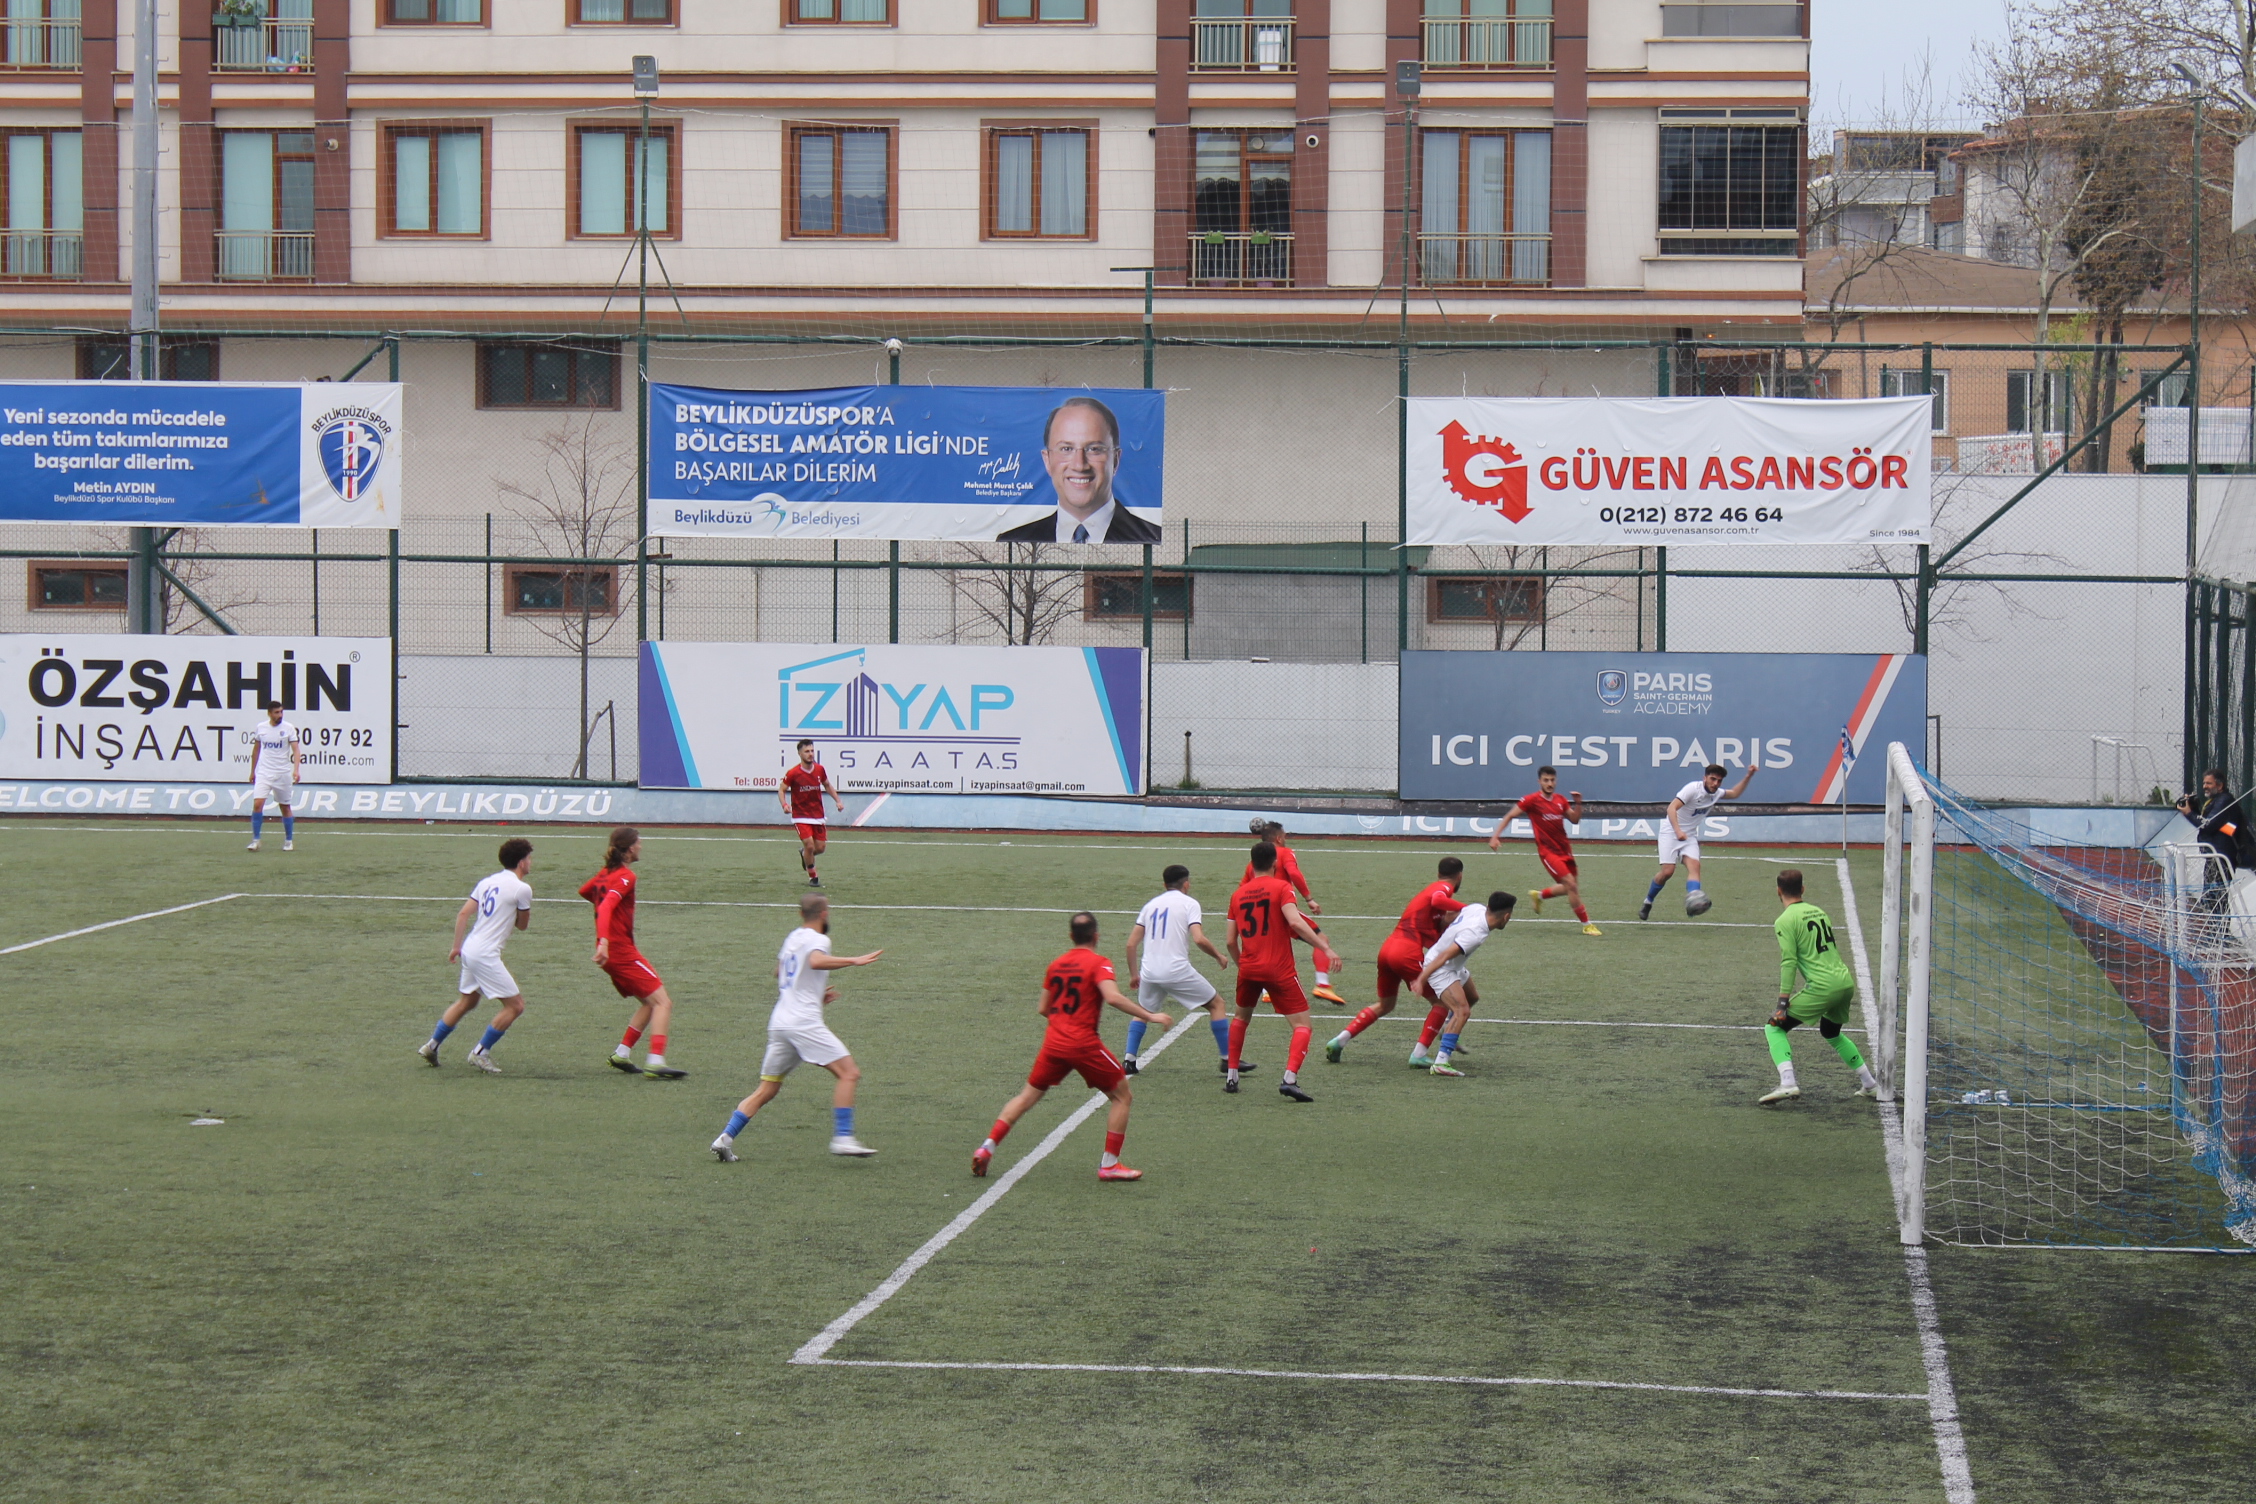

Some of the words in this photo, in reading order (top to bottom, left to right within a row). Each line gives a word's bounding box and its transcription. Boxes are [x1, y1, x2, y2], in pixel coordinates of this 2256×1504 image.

[4, 407, 43, 424] Yeni
[47, 409, 128, 425] sezonda
[132, 409, 226, 426] mücadele
[311, 404, 392, 435] BEYLİKDÜZÜSPOR
[675, 400, 895, 426] BEYLİKDÜZÜSPOR'A
[0, 430, 48, 446] eden
[52, 430, 91, 447] tüm
[96, 431, 228, 449] takımlarımıza
[675, 427, 784, 453] BÖLGESEL
[789, 430, 889, 454] AMATÖR
[895, 430, 989, 456] LİGİ'NDE
[34, 452, 120, 473] başarılar
[123, 453, 195, 470] dilerim.
[675, 461, 787, 486] BAŞARILAR
[793, 458, 877, 482] DİLERİM
[1540, 447, 1687, 491] GÜVEN
[1698, 447, 1909, 491] ASANSÖR
[73, 481, 112, 494] Metin
[113, 482, 156, 494] AYDIN
[963, 481, 992, 490] Mehmet
[993, 482, 1015, 490] Murat
[975, 489, 1000, 497] Belediye
[53, 494, 96, 504] Beylikdüzü
[96, 495, 115, 504] Spor
[144, 495, 175, 505] Başkanı
[674, 509, 753, 526] Beylikdüzü
[791, 511, 860, 529] Belediyesi
[1599, 506, 1667, 525] 0(212)
[1673, 507, 1713, 523] 872
[1719, 507, 1749, 523] 46
[1754, 507, 1784, 523] 64
[1623, 526, 1760, 537] www.guvenasansor.com.tr
[1869, 529, 1895, 537] Since
[1897, 528, 1920, 537] 1984
[28, 647, 351, 715] ÖZŞAHİN
[1633, 672, 1713, 692] PARIS
[1633, 701, 1712, 715] ACADEMY
[36, 715, 235, 770] İNŞAAT
[320, 727, 343, 747] 97
[350, 728, 373, 748] 92
[1430, 734, 1490, 767] ICI
[1505, 733, 1637, 768] C'EST
[1652, 735, 1795, 769] PARIS
[734, 776, 751, 786] Tel:
[752, 777, 777, 787] 0850
[847, 778, 954, 790] www.izyapinsaat.com
[970, 779, 1086, 792] izyapinsaat@gmail.com
[165, 788, 216, 810] TO
[350, 788, 613, 817] BEYLIKDÜZÜ
[1401, 815, 1454, 833] ICI
[1149, 907, 1169, 940] 11
[1240, 898, 1271, 939] 37
[1807, 918, 1837, 955] 24
[1049, 975, 1083, 1016] 25
